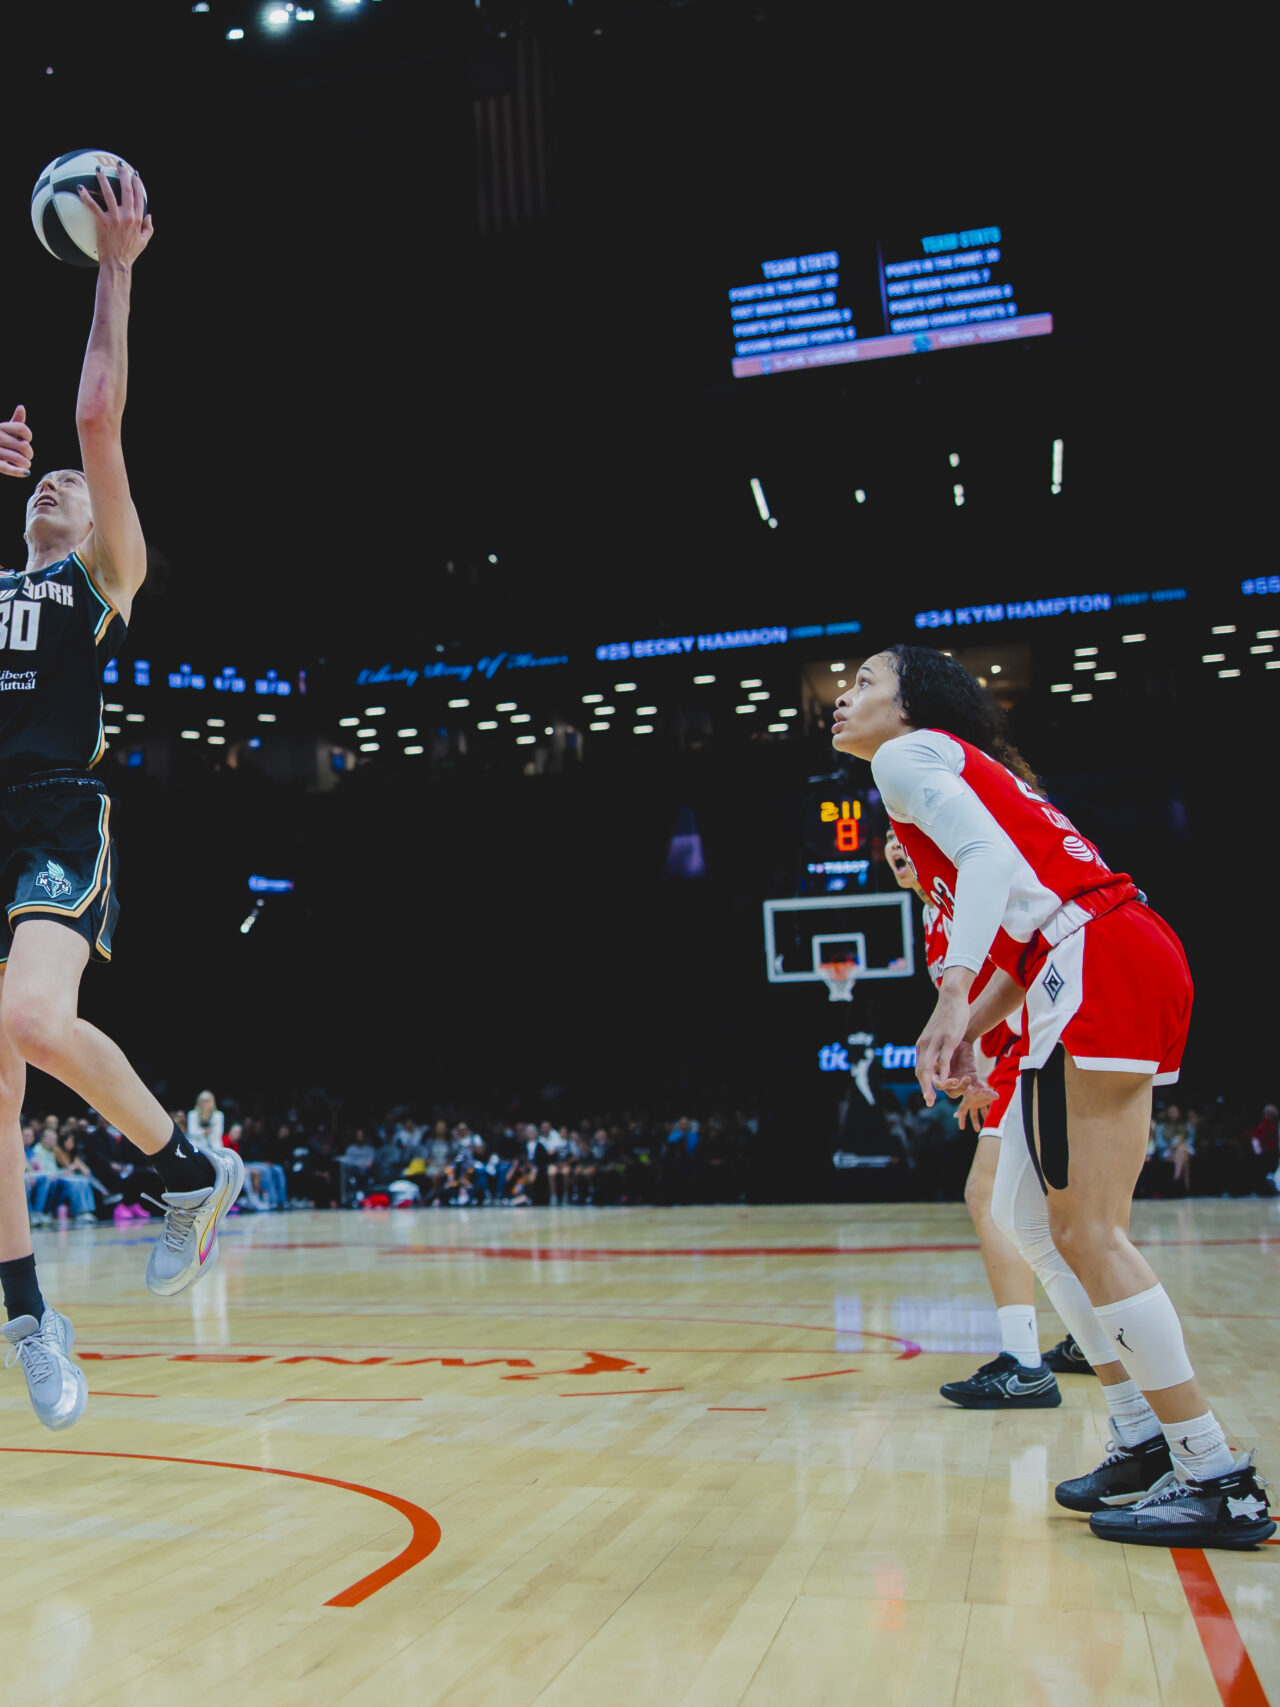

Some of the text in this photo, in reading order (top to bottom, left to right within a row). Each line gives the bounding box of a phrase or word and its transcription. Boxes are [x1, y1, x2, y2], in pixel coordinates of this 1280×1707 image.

[21, 575, 74, 607] YORK
[914, 608, 955, 630] #34
[955, 603, 1005, 626] KYM
[1006, 593, 1112, 621] HAMPTON
[631, 635, 696, 658] BECKY
[697, 626, 788, 651] HAMMON
[836, 818, 859, 851] 8
